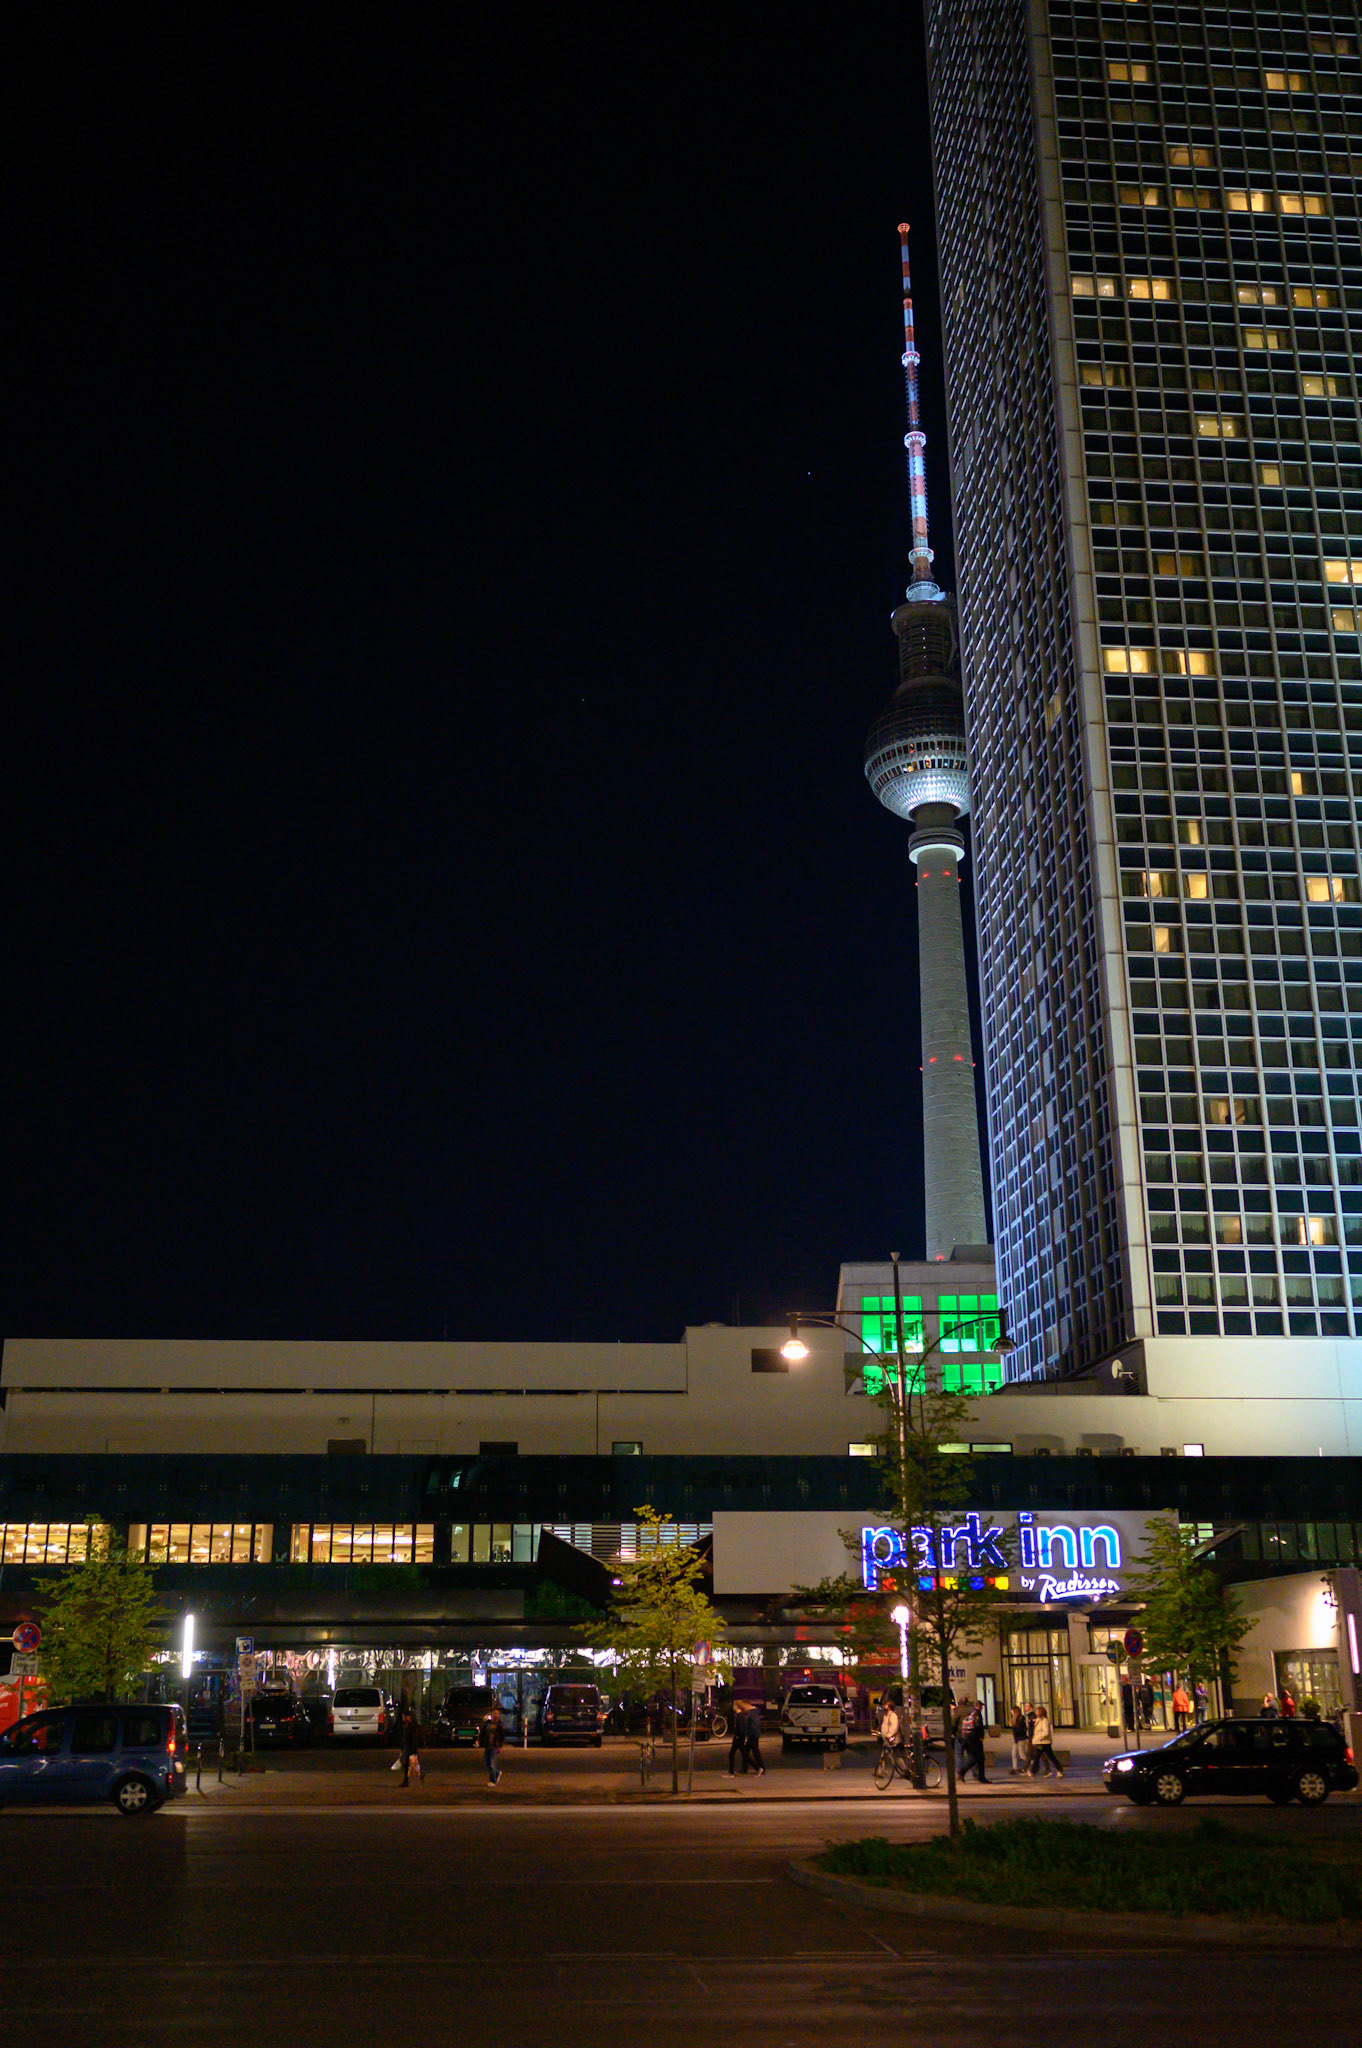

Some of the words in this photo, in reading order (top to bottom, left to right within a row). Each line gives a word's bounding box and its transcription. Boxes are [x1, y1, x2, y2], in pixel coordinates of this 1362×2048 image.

[861, 1512, 1008, 1591] park
[1018, 1511, 1121, 1568] inn
[1020, 1575, 1036, 1591] by
[1038, 1569, 1121, 1603] Radisson
